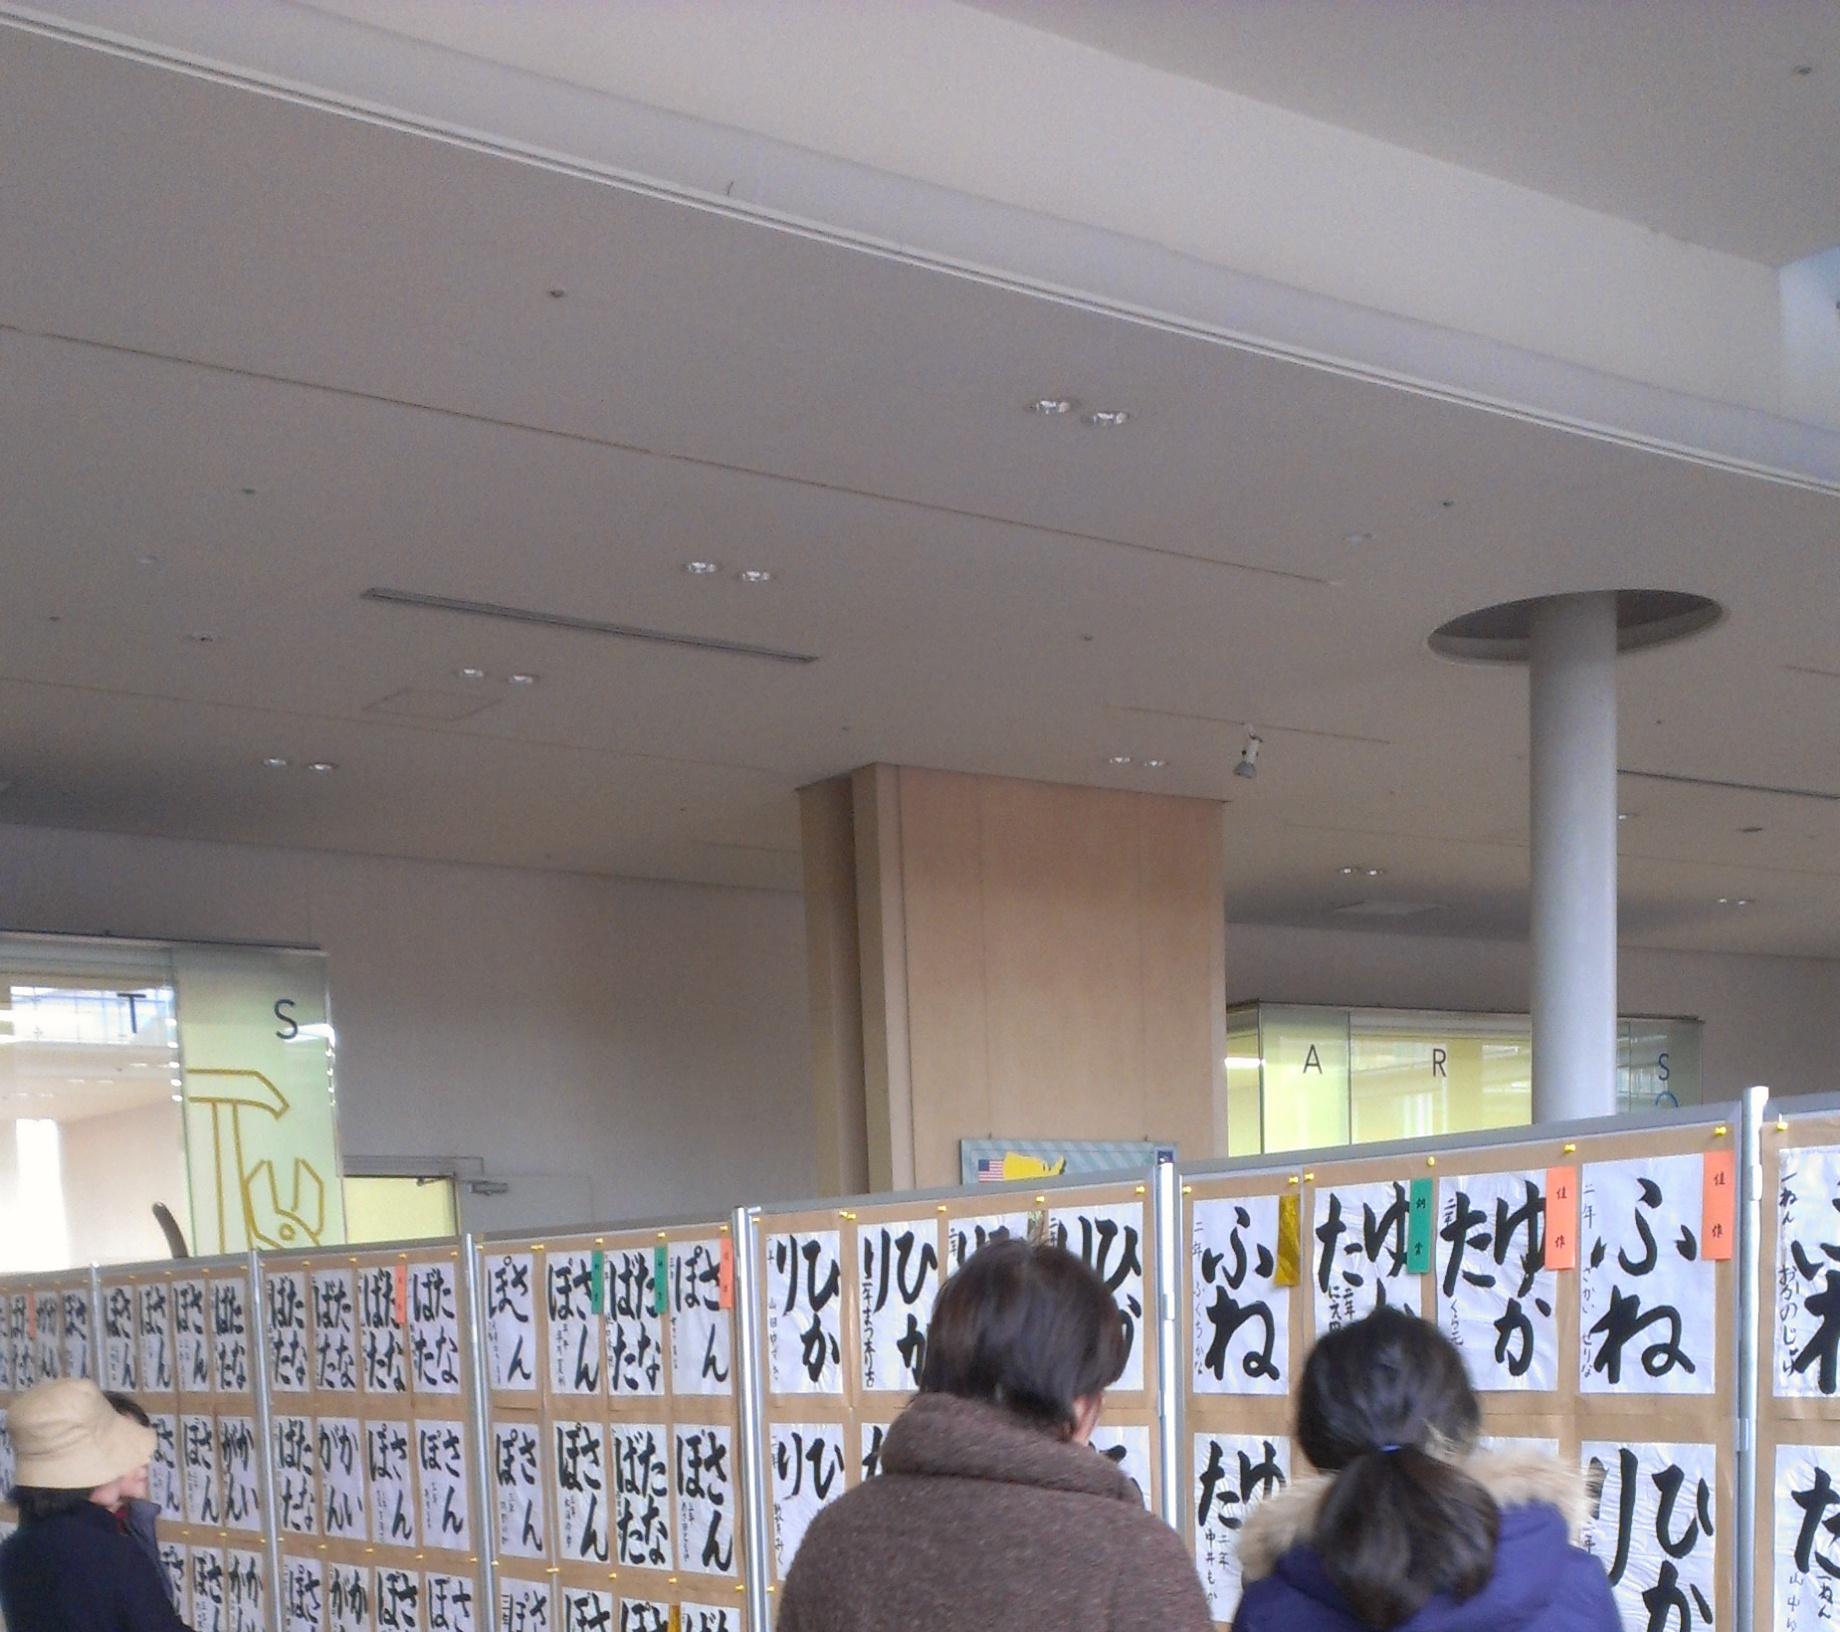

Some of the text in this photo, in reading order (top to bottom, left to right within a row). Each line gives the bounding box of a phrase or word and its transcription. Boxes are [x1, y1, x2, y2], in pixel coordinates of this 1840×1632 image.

[274, 1000, 299, 1039] S
[1303, 1045, 1671, 1082] A R S
[1202, 1206, 1280, 1381] ふね
[1590, 1177, 1698, 1385] ふね
